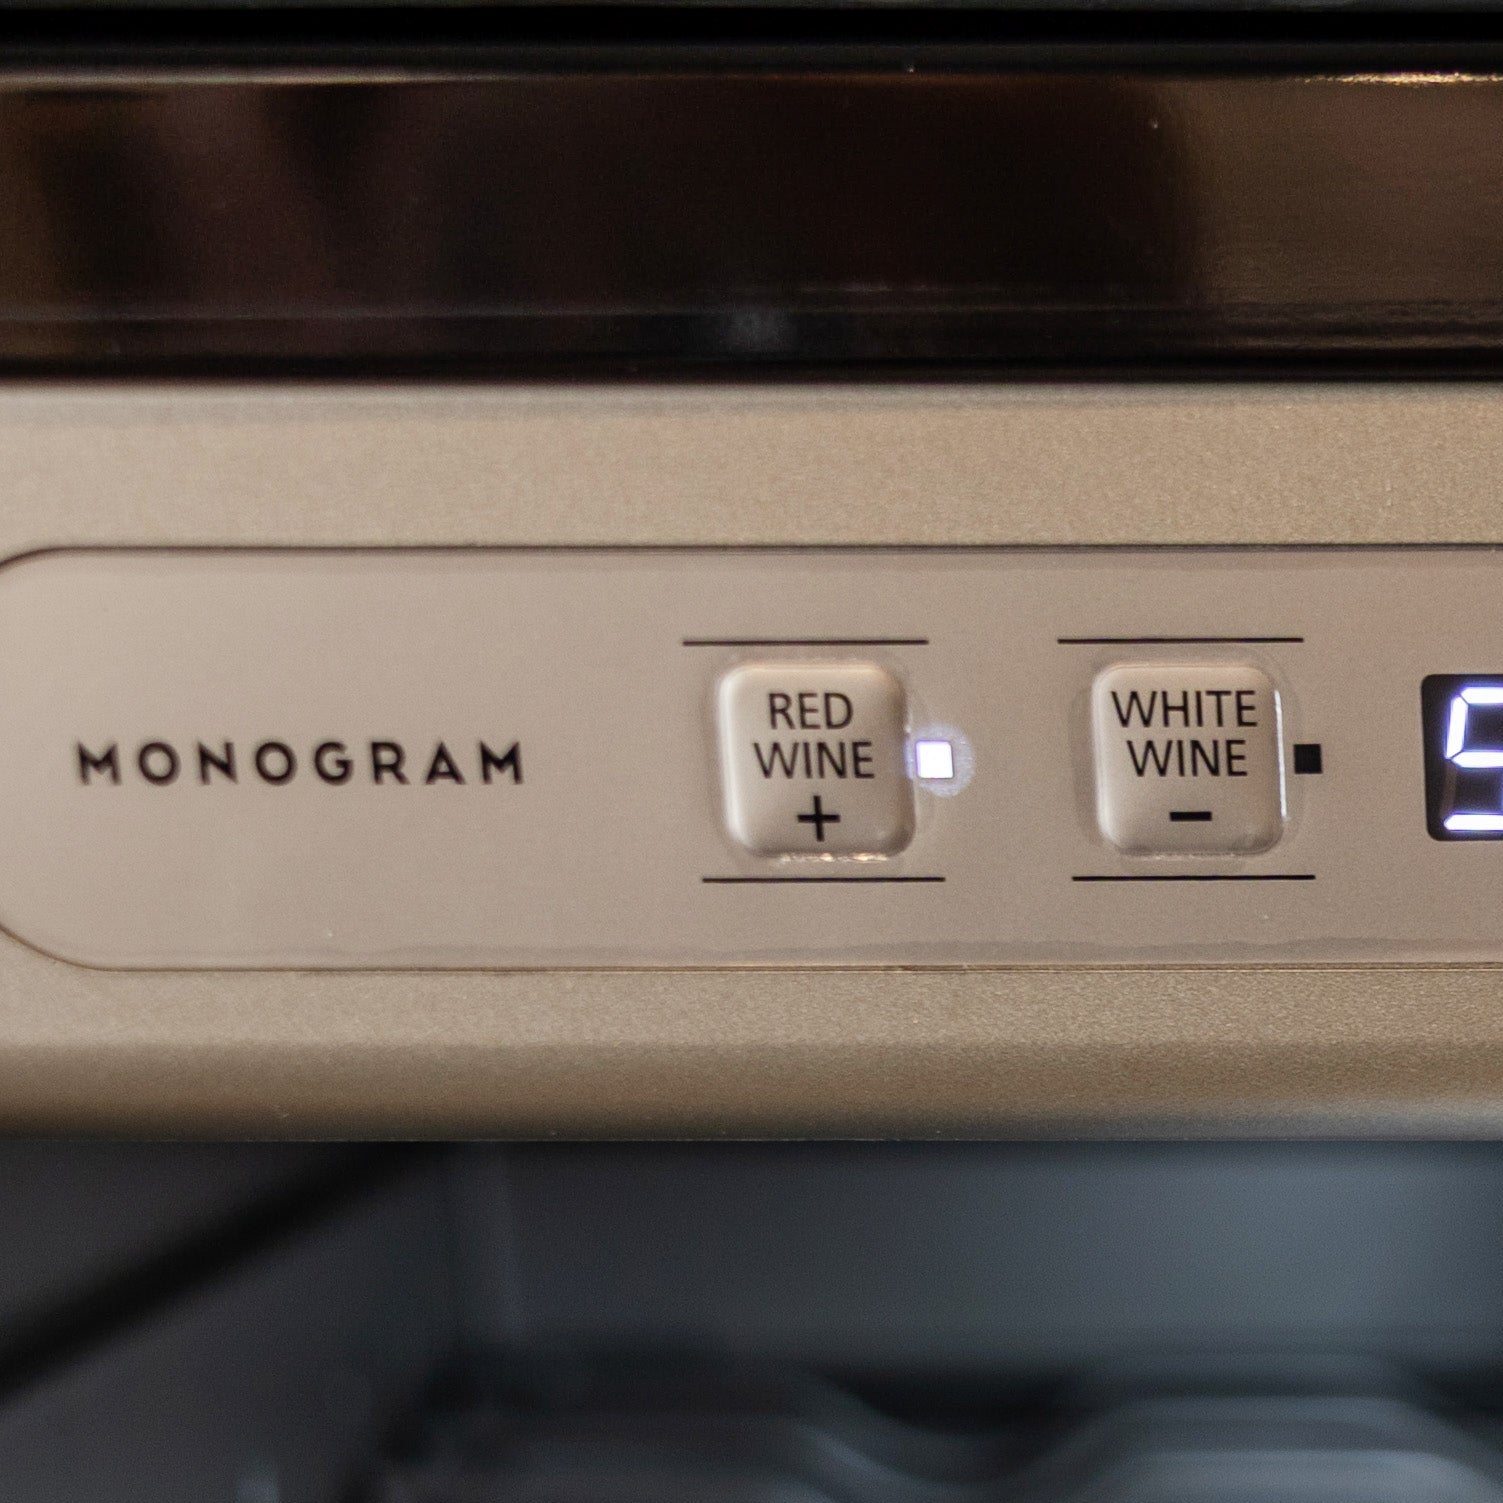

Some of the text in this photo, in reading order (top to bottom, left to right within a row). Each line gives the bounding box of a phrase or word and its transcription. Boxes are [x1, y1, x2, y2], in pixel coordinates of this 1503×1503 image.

[768, 692, 854, 730] RED
[1111, 689, 1259, 728] WHITE
[77, 741, 524, 786] MONOGRAM
[753, 740, 875, 779] WINE
[1126, 739, 1248, 777] WINE
